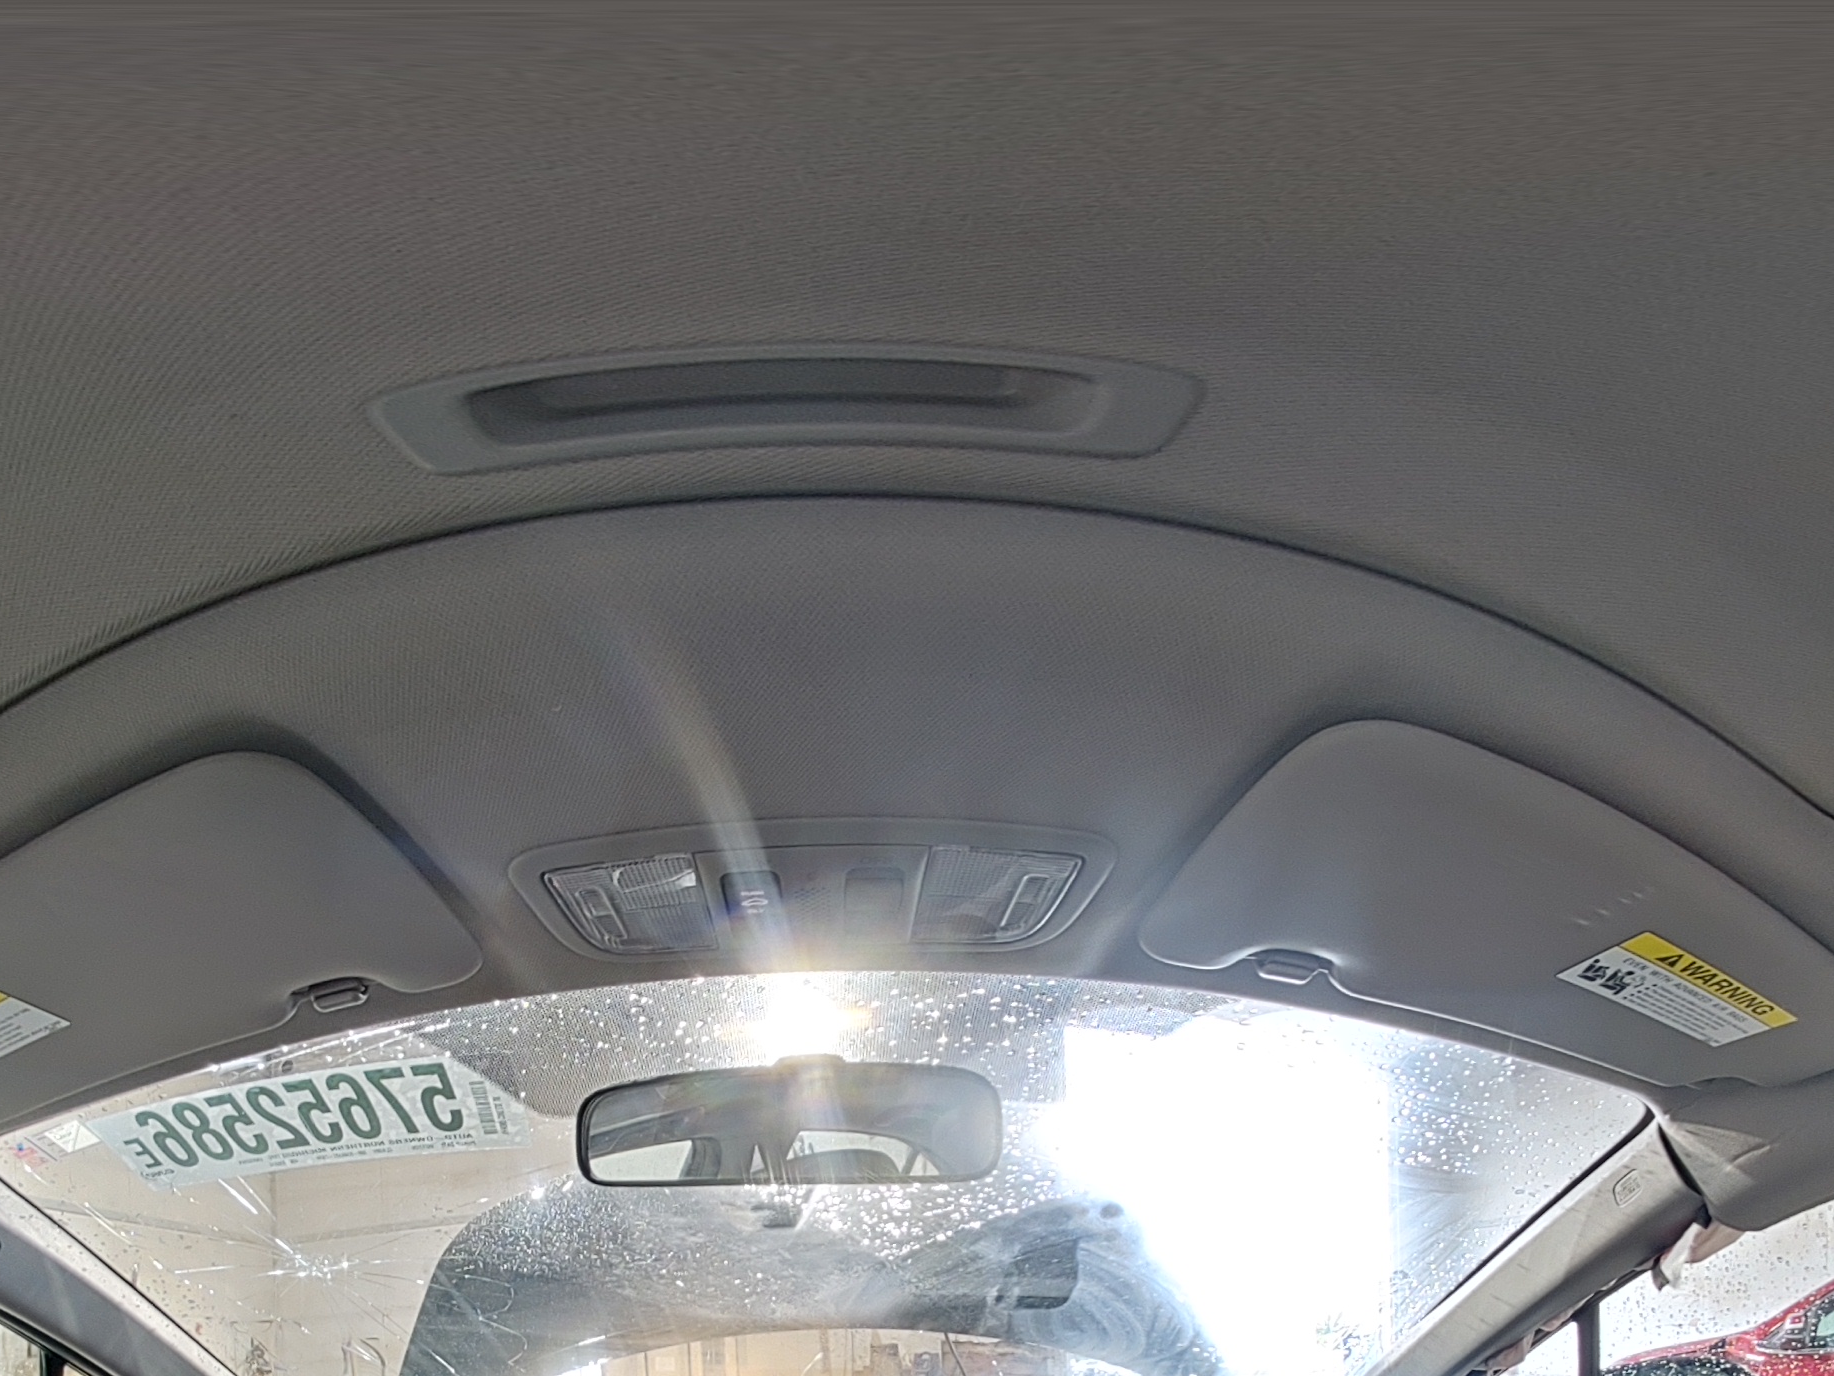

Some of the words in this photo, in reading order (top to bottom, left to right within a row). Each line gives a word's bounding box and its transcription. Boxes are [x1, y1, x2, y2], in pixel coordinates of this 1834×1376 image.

[1623, 957, 1648, 971] EVEN
[1649, 968, 1673, 983] WITH
[1674, 980, 1713, 1003] ADVANCED
[1680, 961, 1775, 1016] WARNING
